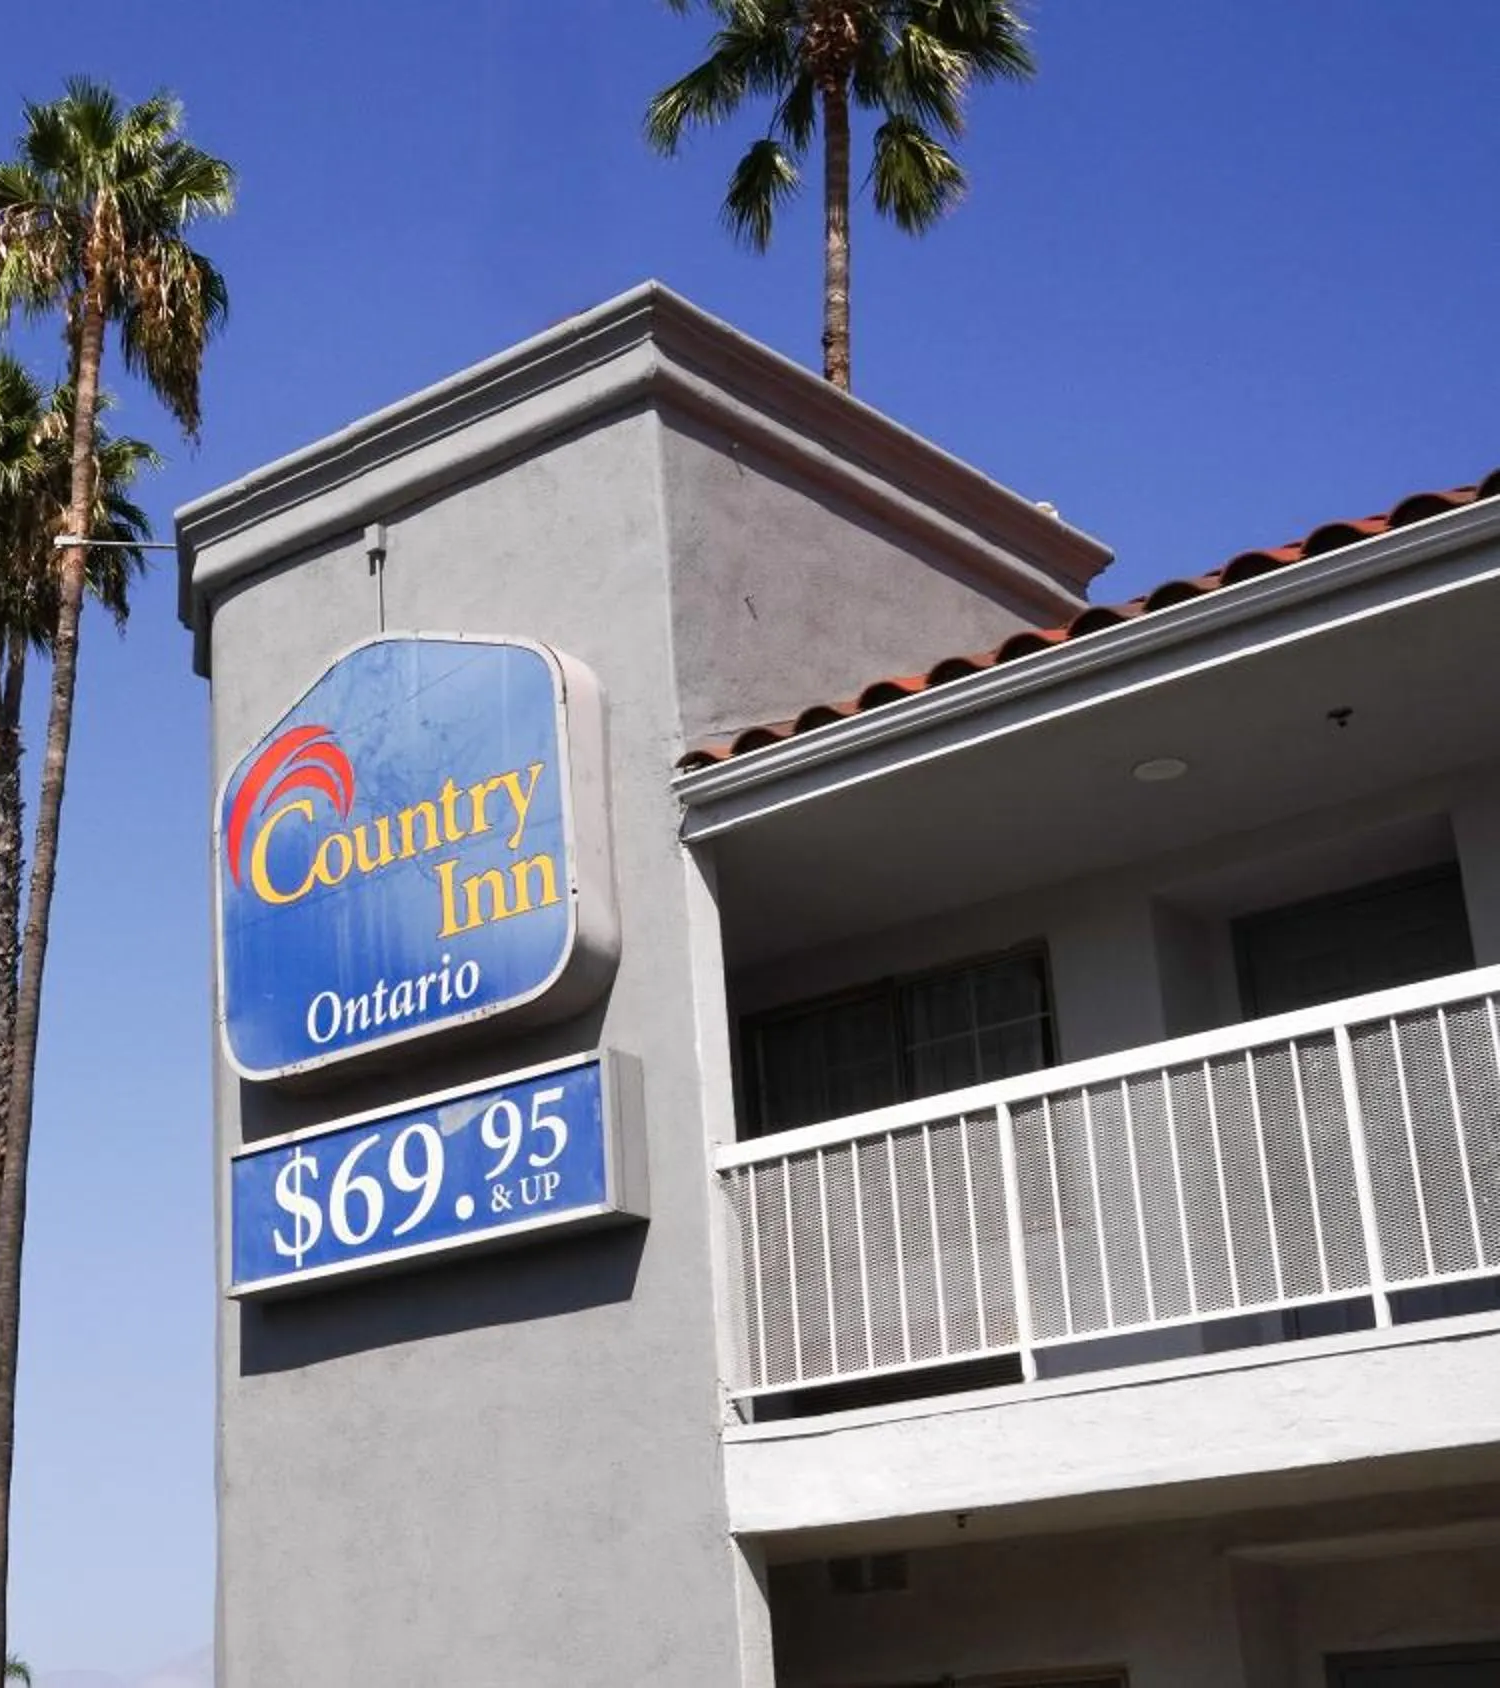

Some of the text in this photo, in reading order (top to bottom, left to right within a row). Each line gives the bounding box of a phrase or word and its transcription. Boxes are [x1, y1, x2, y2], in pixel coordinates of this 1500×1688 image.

[250, 761, 544, 905] Country
[435, 852, 561, 939] Inn
[307, 954, 481, 1043] Ontario
[491, 1171, 561, 1213] & UP
